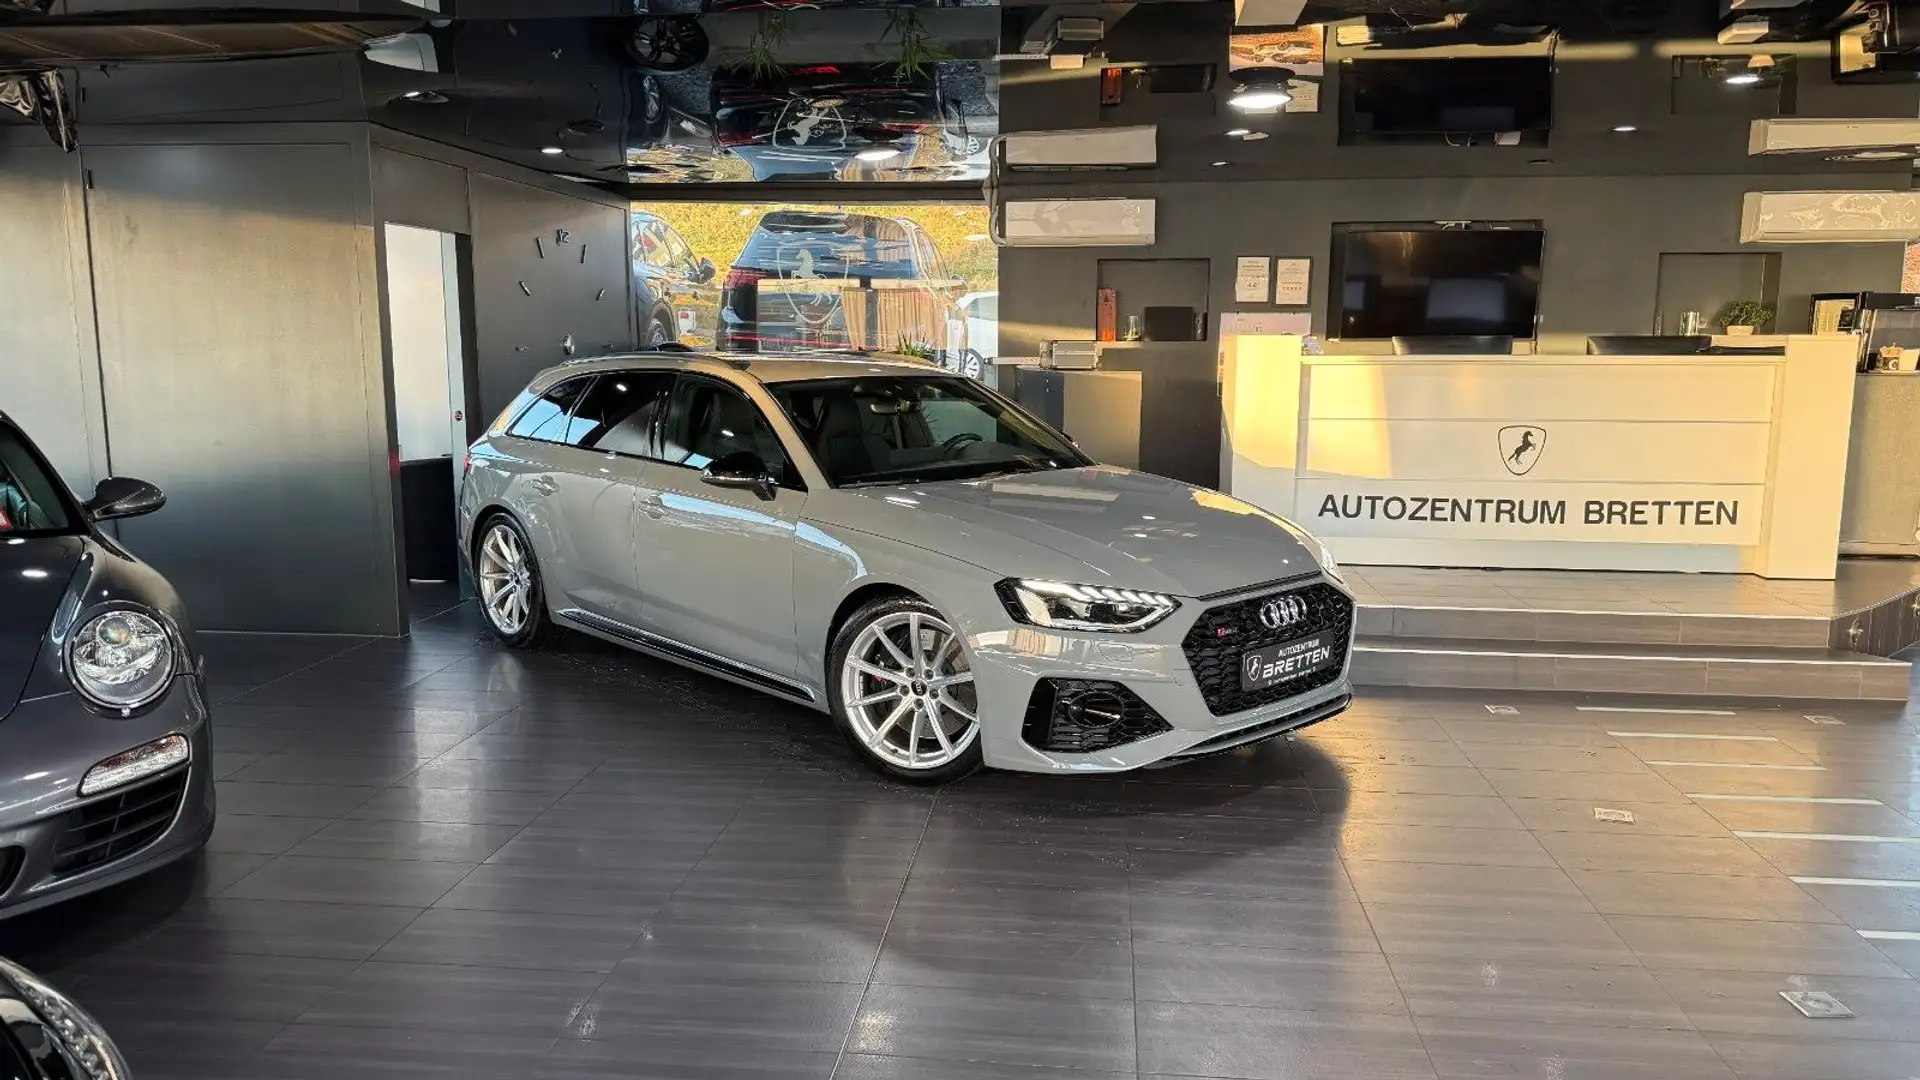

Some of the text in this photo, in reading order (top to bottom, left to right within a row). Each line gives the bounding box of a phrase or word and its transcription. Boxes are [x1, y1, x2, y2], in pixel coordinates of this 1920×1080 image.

[1317, 494, 1739, 526] AUTOZENTRUM BRETTEN
[1262, 645, 1331, 679] BRETTEN
[1278, 638, 1320, 657] AUTOZENTRUM
